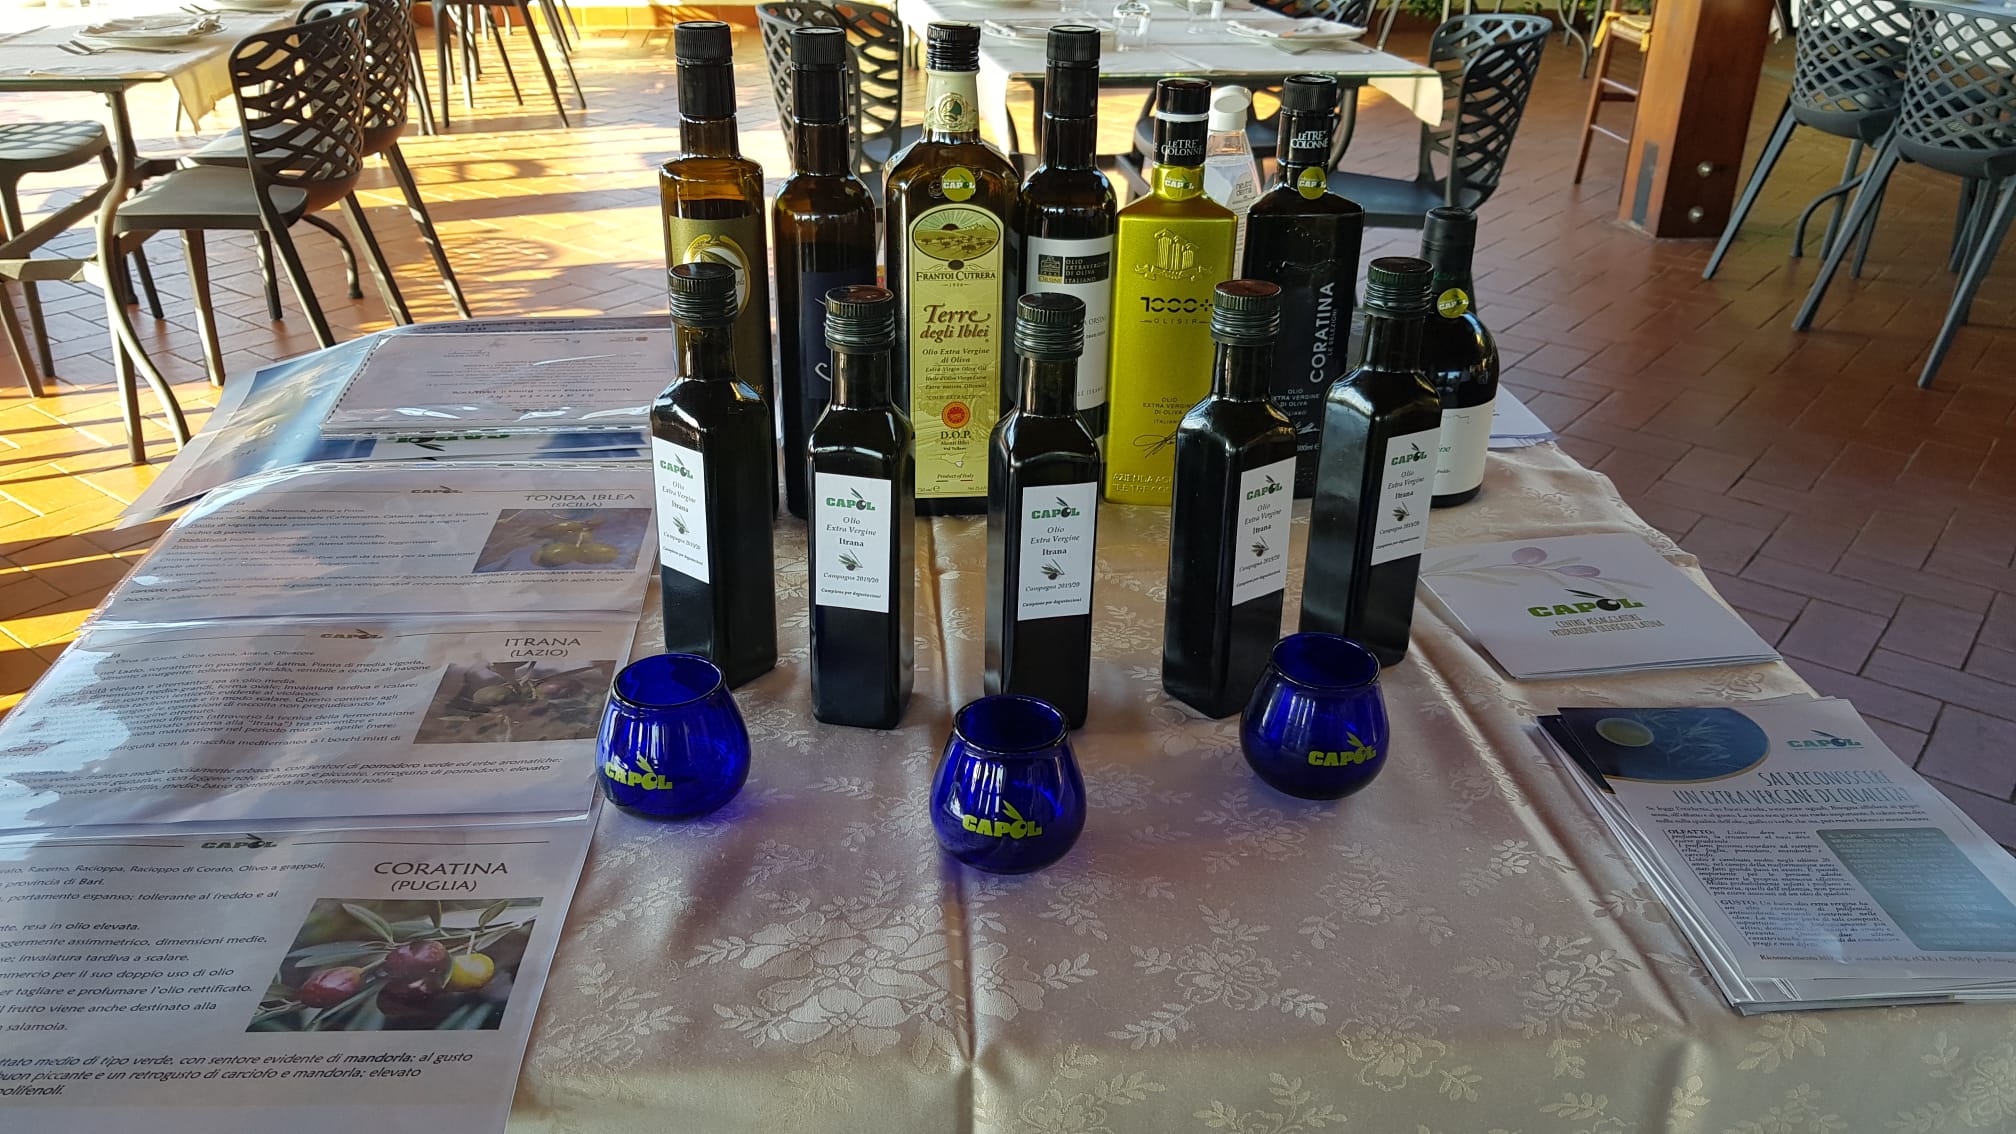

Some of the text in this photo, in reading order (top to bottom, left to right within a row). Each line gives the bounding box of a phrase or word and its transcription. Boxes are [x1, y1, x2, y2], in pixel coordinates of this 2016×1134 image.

[1291, 136, 1328, 148] COLONNE
[916, 271, 996, 281] FRANTOI CUTRERA
[923, 303, 991, 324] Terre
[920, 325, 953, 343] degli
[1310, 282, 1335, 383] CORATINA
[963, 348, 990, 356] Vergine
[940, 431, 971, 440] D.O.P.
[1391, 451, 1427, 465] CAPOL
[660, 460, 693, 479] CAPOL
[1246, 482, 1282, 500] CAPOL
[826, 497, 876, 511] CAPOL
[1031, 506, 1080, 519] CAPOL
[843, 516, 861, 525] Olio
[826, 524, 877, 537] Extra Vergine
[1047, 526, 1065, 534] Olio
[839, 538, 864, 547] Itrana
[1030, 534, 1080, 545] Extra Vergine
[1042, 548, 1067, 556] Itrana
[1528, 598, 1646, 617] CAPOL
[505, 637, 581, 647] ITRANA
[510, 649, 569, 658] (LAZIO)
[1787, 737, 1863, 748] CAPOL
[1308, 746, 1376, 766] CAPOL
[605, 761, 673, 790] CAPOL
[1699, 789, 1750, 805] EXTRA
[1746, 788, 1816, 804] VERGINE
[962, 814, 1042, 839] CAPOL
[201, 838, 277, 849] CAPOL
[75, 864, 125, 874] Racioppa,
[130, 865, 180, 874] Racioppo
[182, 865, 194, 873] di
[238, 863, 269, 872] Olivo
[373, 861, 509, 876] CORATINA
[5, 878, 61, 889] provincia
[63, 878, 75, 886] di
[391, 879, 477, 893] (PUGLIA)
[7, 892, 80, 903] portamento
[139, 892, 197, 901] tollerante
[199, 892, 211, 900] al
[211, 891, 253, 901] freddo
[266, 890, 278, 899] al
[49, 923, 62, 931] in
[65, 922, 91, 931] olio
[93, 922, 140, 931] elevata.
[155, 936, 225, 946] dimensioni
[20, 953, 190, 962] invaiatura tardiva a scalare.
[52, 970, 76, 981] per
[78, 969, 88, 978] il
[116, 969, 163, 981] doppio
[192, 969, 207, 977] di
[209, 967, 234, 976] olio
[16, 987, 62, 998] tagliare
[75, 986, 147, 998] profumare
[188, 983, 253, 994] rettificato.
[6, 1001, 217, 1013] frutto viene anche destinato alla
[7, 1022, 68, 1032] salamoia.
[33, 1056, 80, 1067] medio
[83, 1056, 101, 1066] di
[100, 1056, 130, 1068] tipo
[179, 1057, 207, 1065] con
[207, 1055, 261, 1065] sentore
[263, 1053, 327, 1064] evidente
[326, 1053, 342, 1063] di
[342, 1052, 415, 1063] mandorla;
[419, 1052, 435, 1062] al
[433, 1052, 473, 1065] gusto
[31, 1070, 92, 1082] piccante
[94, 1072, 102, 1080] e
[106, 1071, 126, 1080] un
[128, 1070, 201, 1082] retrogusto
[203, 1068, 221, 1079] di
[220, 1068, 279, 1080] carciofo
[280, 1070, 291, 1078] e
[292, 1067, 364, 1079] mandorla;
[369, 1067, 421, 1078] elevato
